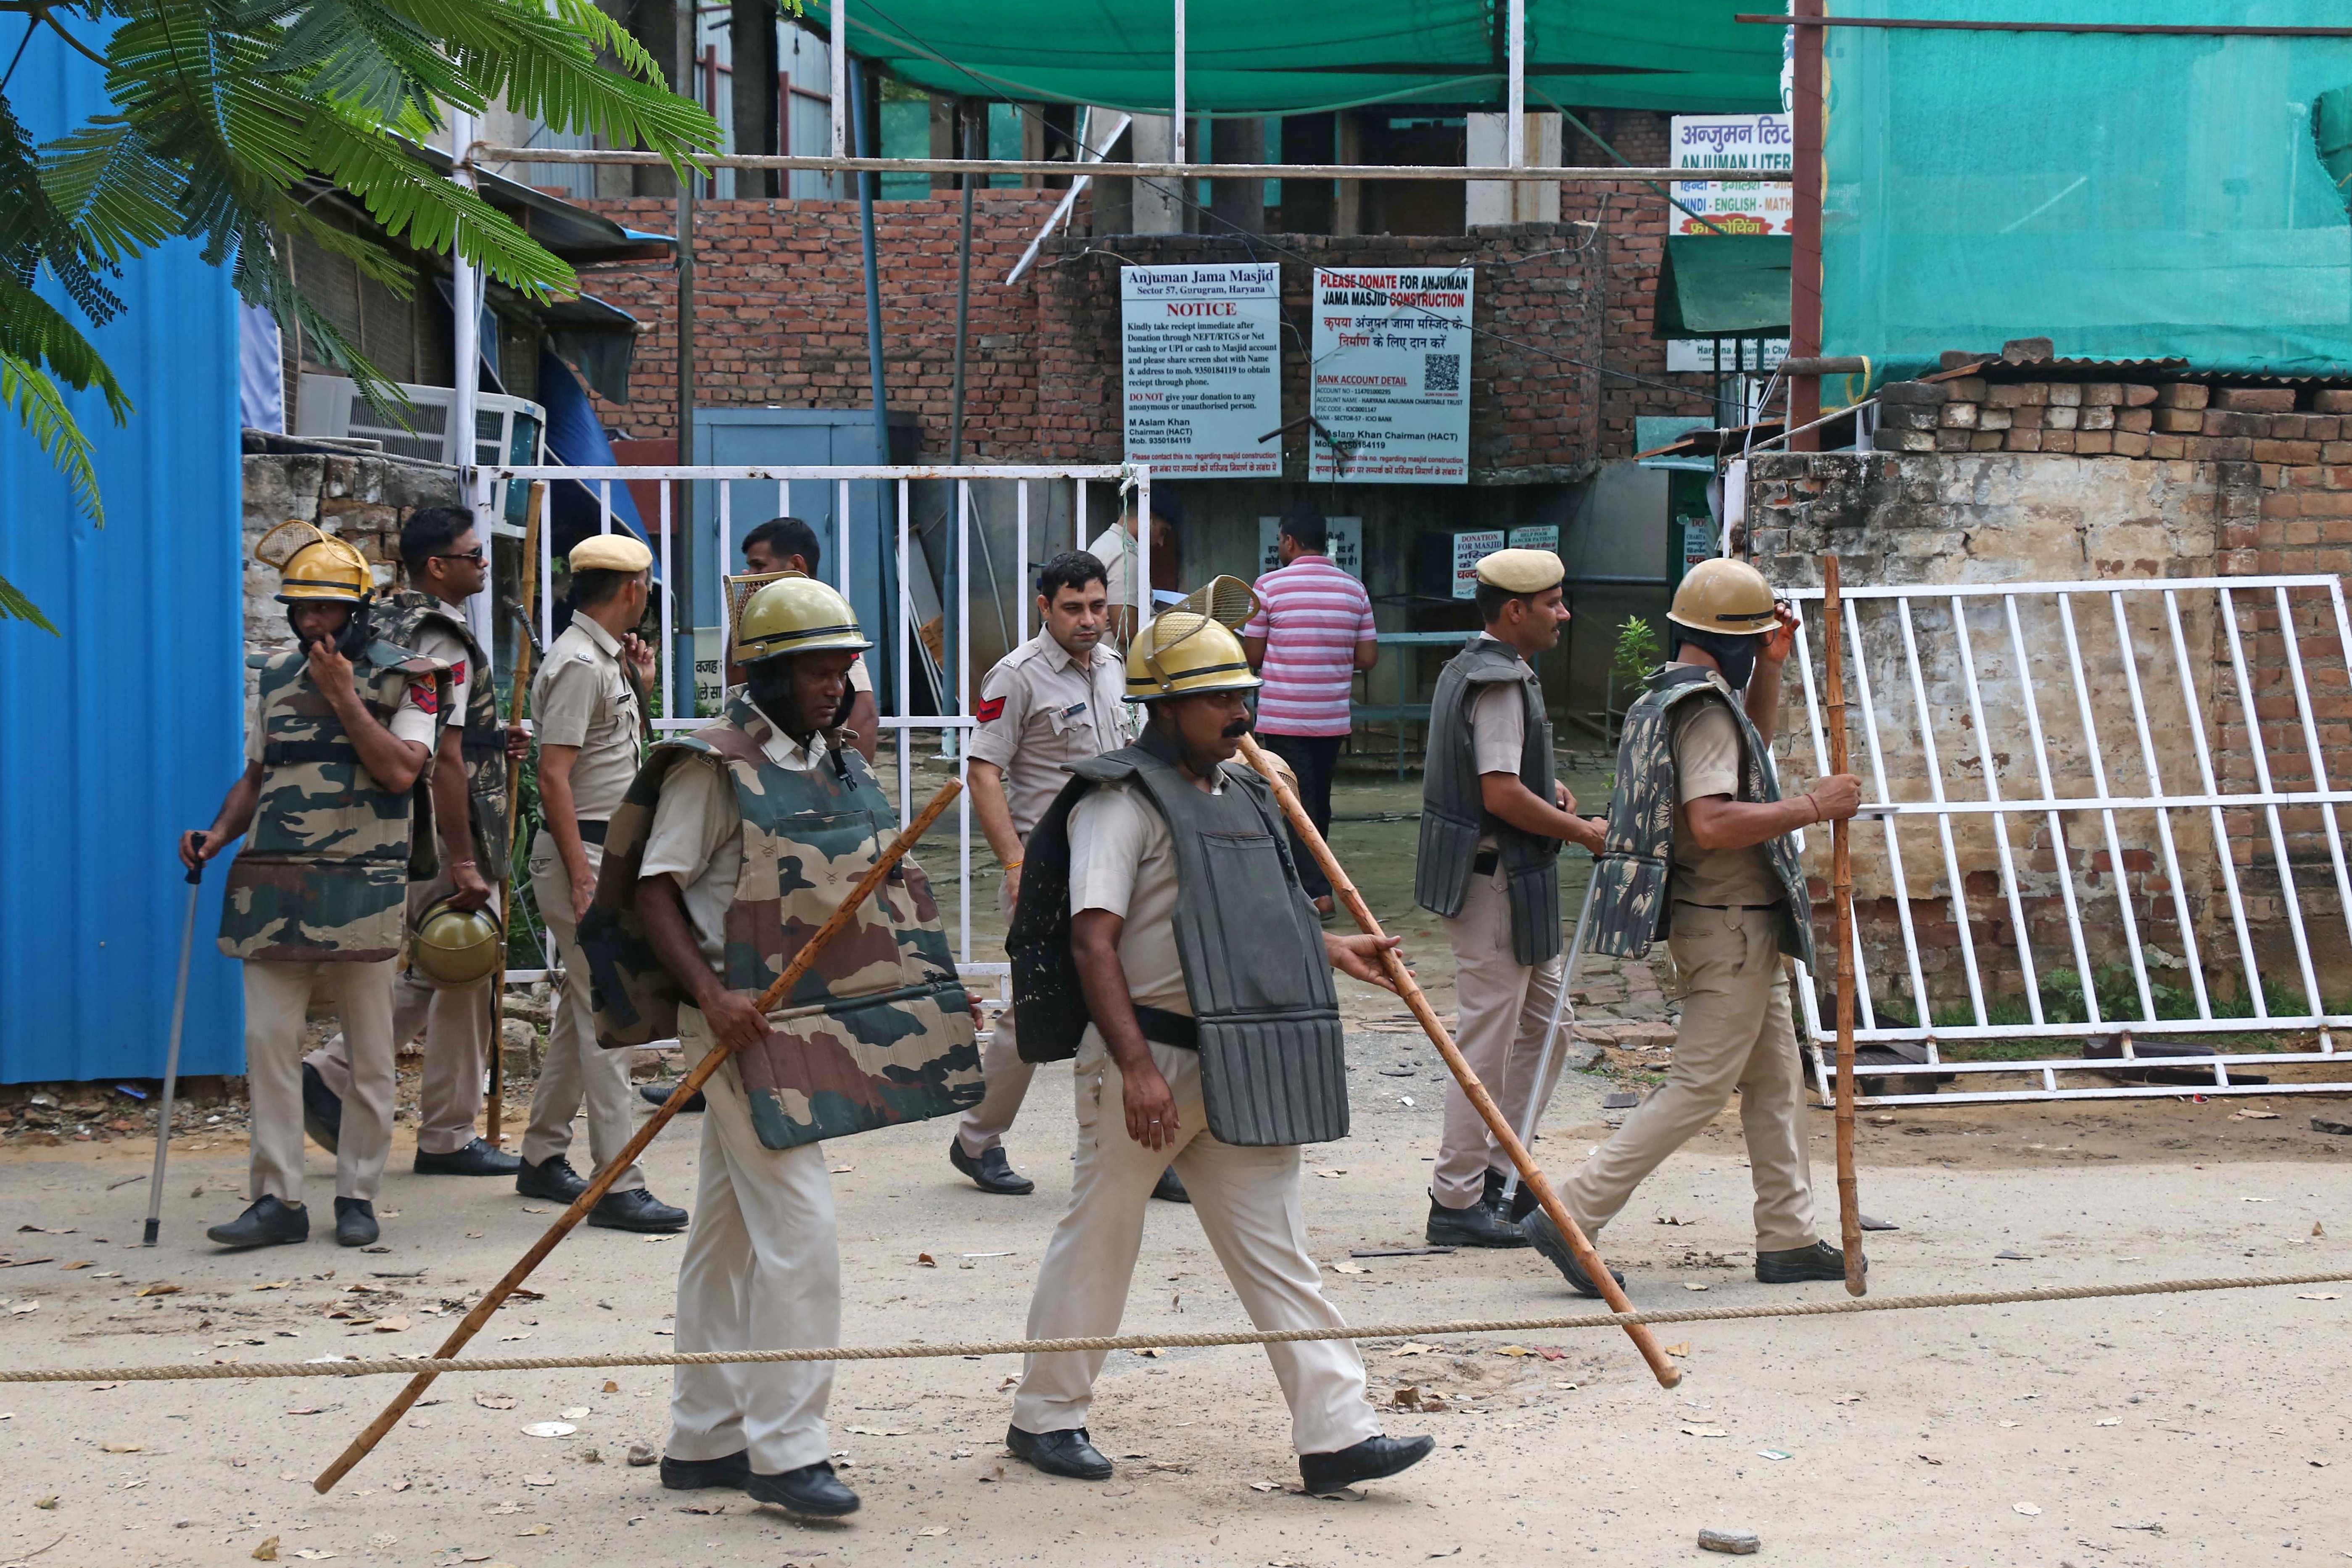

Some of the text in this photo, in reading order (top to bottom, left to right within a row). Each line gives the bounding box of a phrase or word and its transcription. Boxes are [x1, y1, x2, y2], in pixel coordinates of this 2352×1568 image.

[1682, 125, 1753, 153] अन्जुमन
[1715, 198, 1756, 211] ENGLISH
[1129, 269, 1273, 285] Anjuman Jama Masjid
[1321, 275, 1468, 290] PLEASE DONATE FOR ANJUMAN
[1180, 286, 1227, 295] Gurugram,
[1230, 285, 1264, 295] Haryana
[1323, 291, 1464, 307] JAMA MASJID CONSTRUCTION
[1167, 302, 1237, 316] NOTICE
[1127, 323, 1151, 331] Kindly
[1324, 317, 1352, 331] कृपया
[1391, 319, 1414, 329] जामा
[1163, 334, 1191, 342] through
[1193, 333, 1240, 341] NEFT/RTGS
[1373, 334, 1383, 347] के
[1387, 334, 1407, 350] लिए
[1410, 338, 1426, 347] दान
[1222, 344, 1246, 353] Masjid
[1185, 378, 1209, 387] phone.
[1381, 376, 1407, 385] DETAIL
[1428, 433, 1457, 441] (HACT)
